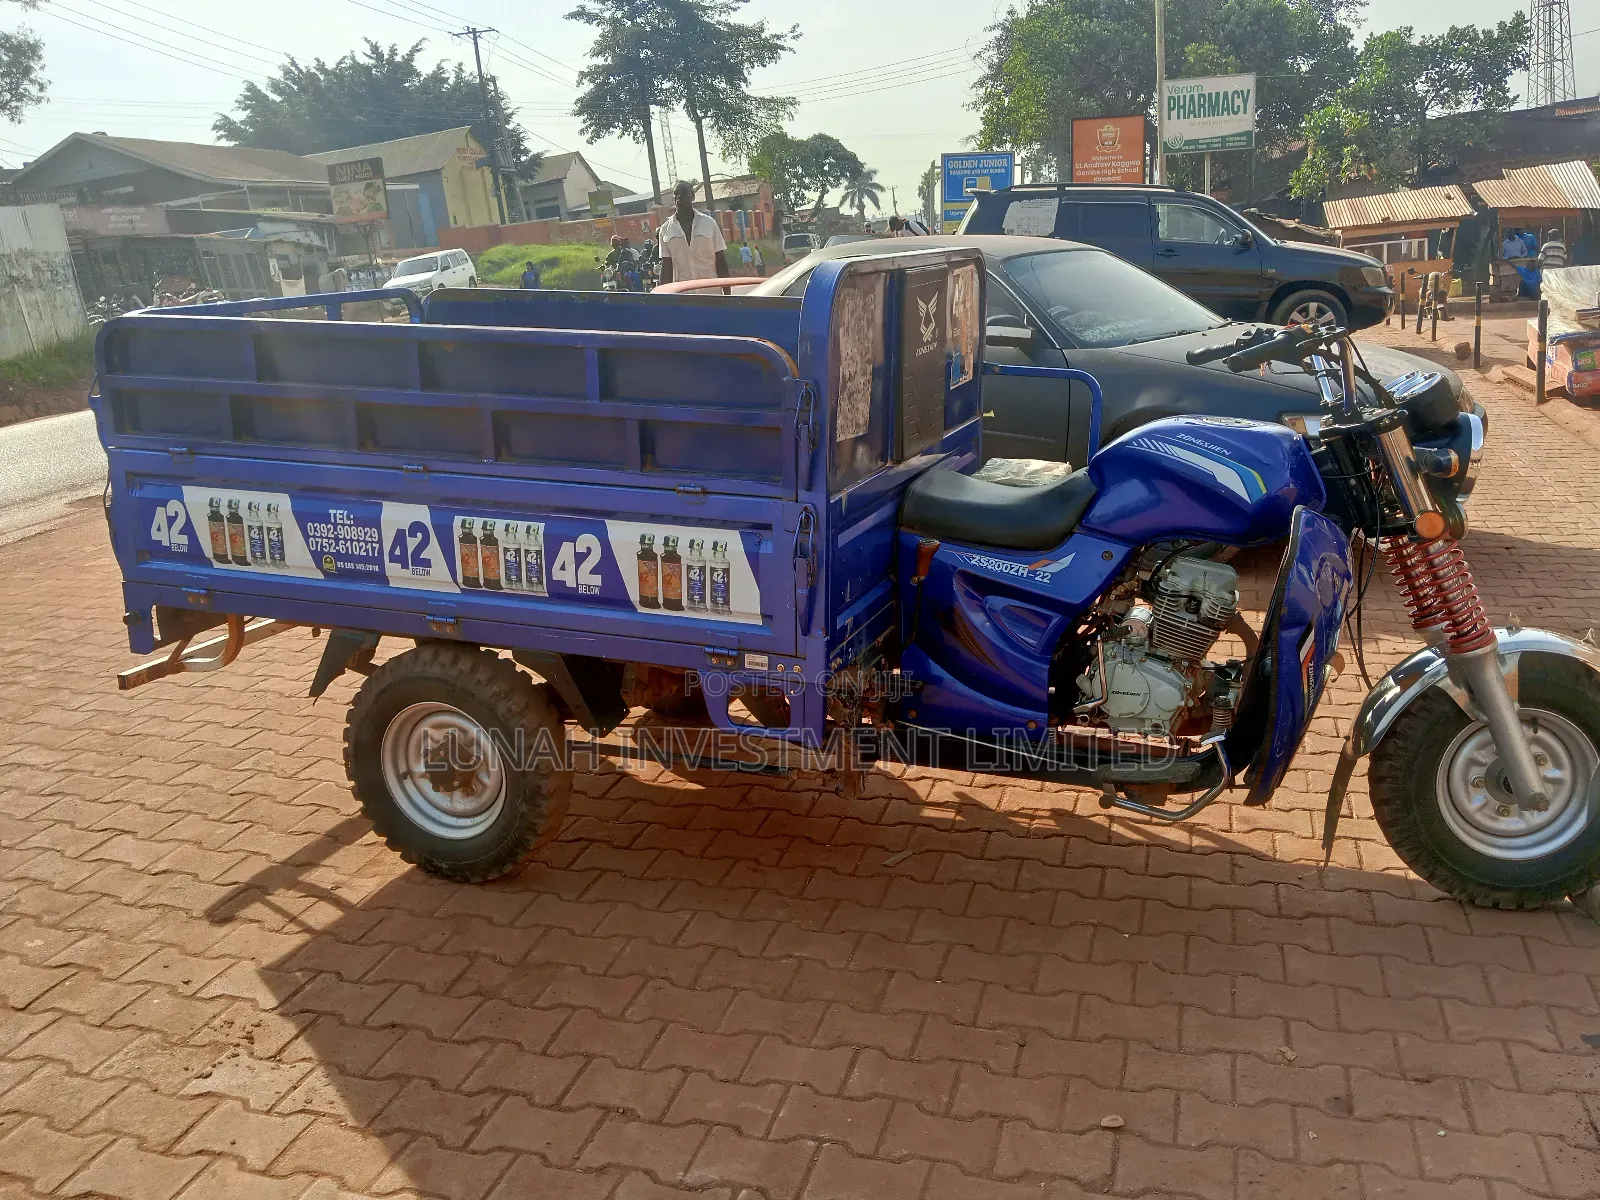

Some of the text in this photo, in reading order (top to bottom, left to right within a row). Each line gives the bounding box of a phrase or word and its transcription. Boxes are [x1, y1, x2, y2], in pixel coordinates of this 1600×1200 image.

[1167, 84, 1203, 95] Verum
[1167, 88, 1251, 121] PHARMACY
[336, 161, 372, 178] NINA
[948, 159, 1008, 169] GOLDEN JUNIOR
[1111, 160, 1141, 168] Kaggwa
[1176, 432, 1232, 456] ZONGSHEN
[150, 499, 188, 547] 42
[328, 509, 354, 525] TEL:
[307, 522, 379, 542] 0392-908929
[171, 542, 188, 553] BELOW
[308, 537, 380, 557] 0752-610217
[388, 520, 432, 571] 42
[551, 533, 603, 588] 42
[969, 554, 1053, 584] ZS200ZH-22
[411, 567, 431, 577] BELOW
[577, 584, 601, 596] BELOW
